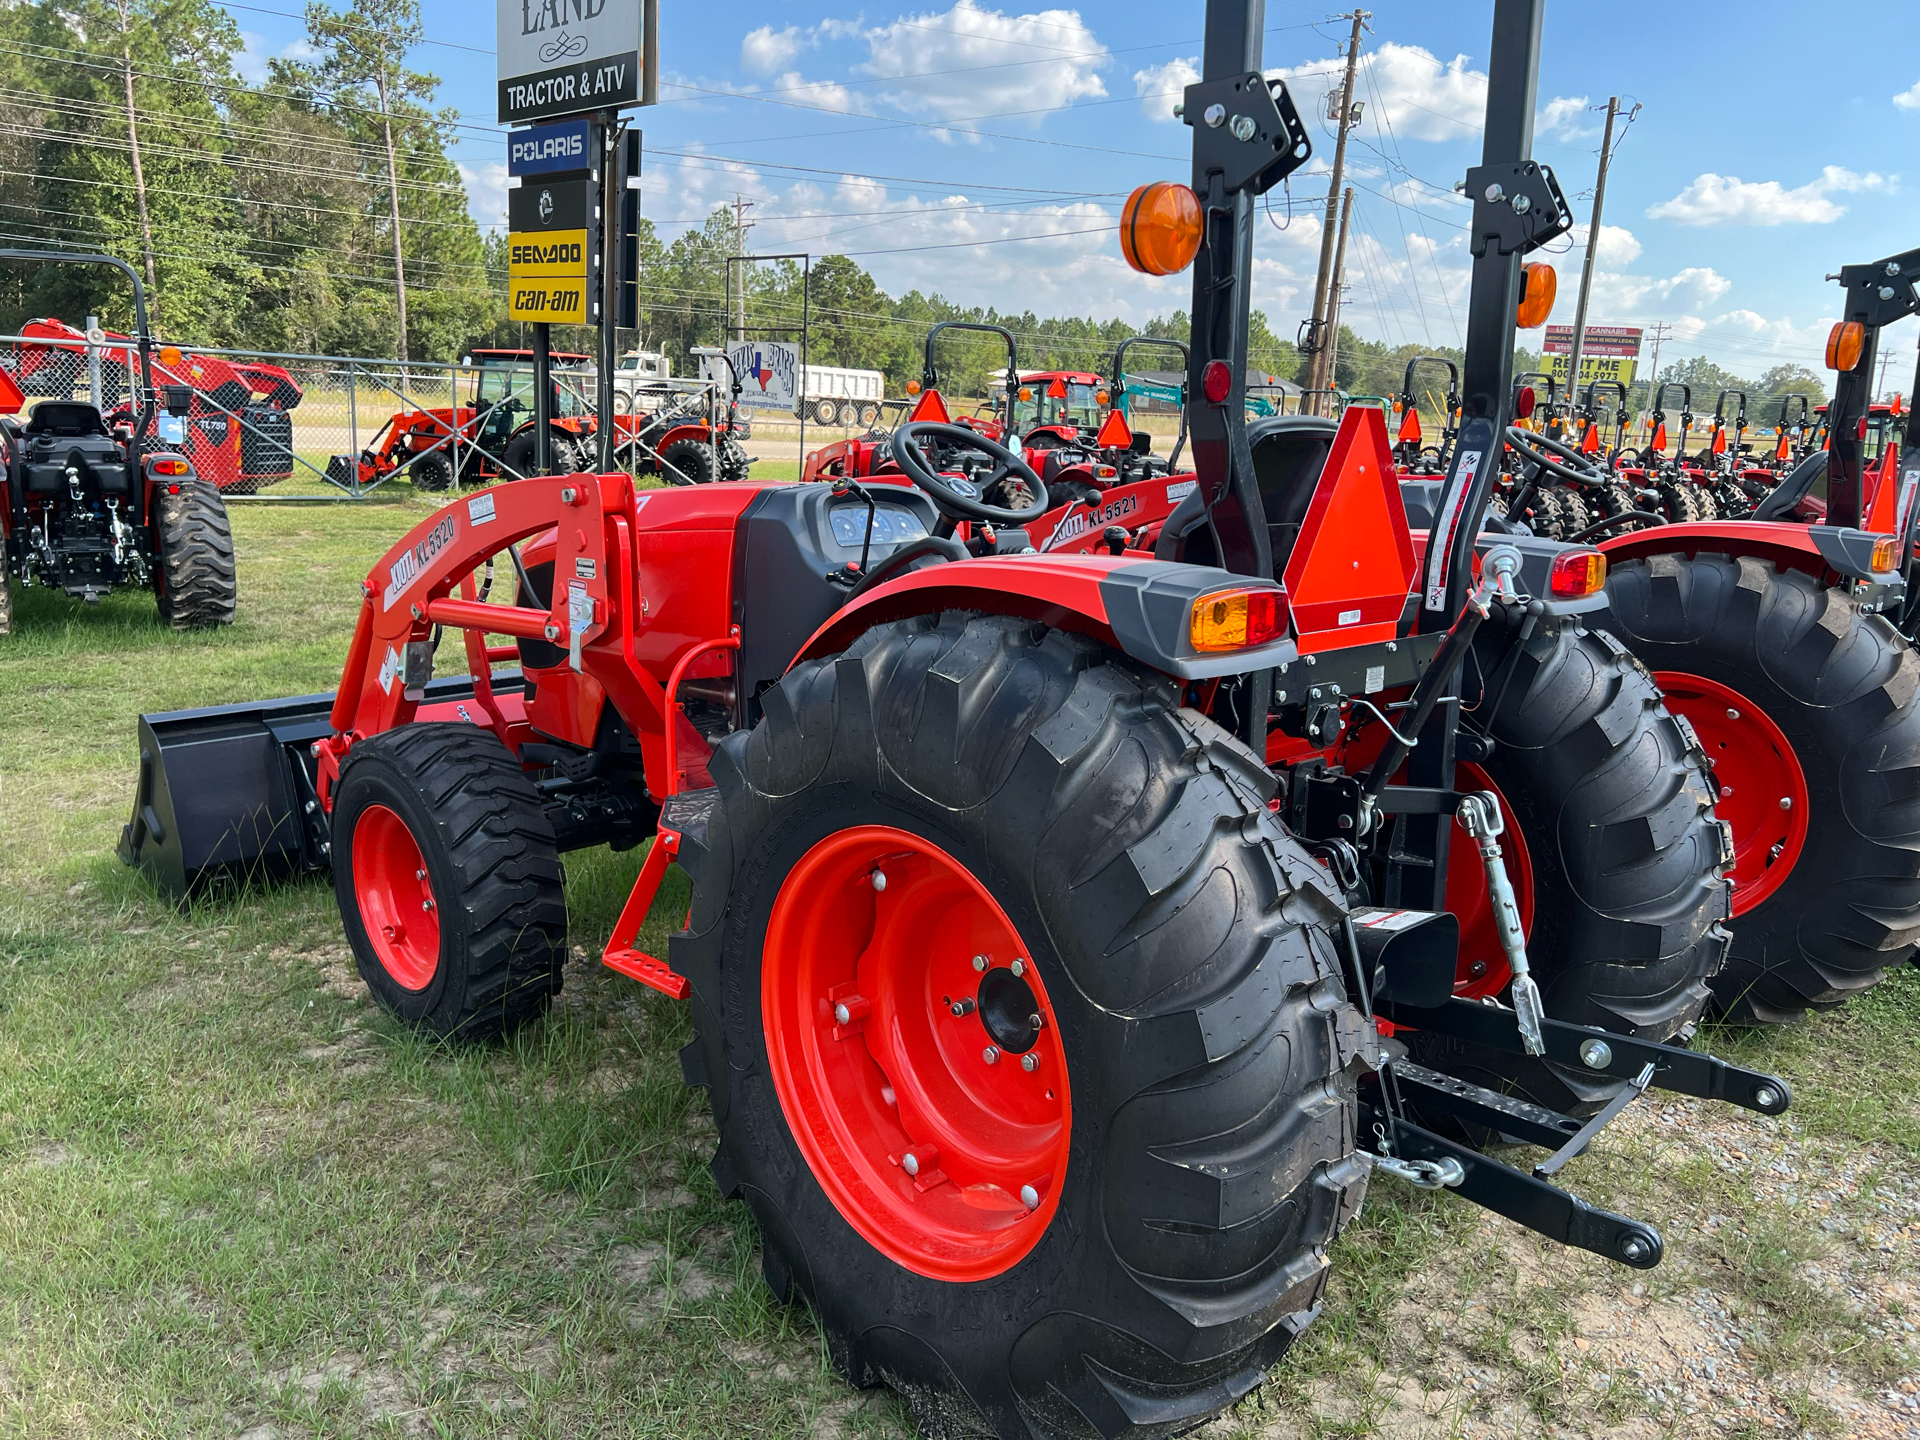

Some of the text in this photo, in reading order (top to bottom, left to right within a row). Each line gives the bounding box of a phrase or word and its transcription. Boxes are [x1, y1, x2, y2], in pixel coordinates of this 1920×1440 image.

[521, 0, 606, 36] LAND
[507, 63, 626, 110] TRACTOR & ATV
[512, 134, 583, 163] POLARIS
[515, 290, 580, 311] can-am
[1552, 357, 1620, 371] RET ME
[744, 389, 778, 401] TRAILERS
[200, 420, 227, 431] TL750
[389, 547, 416, 595] KIOTI
